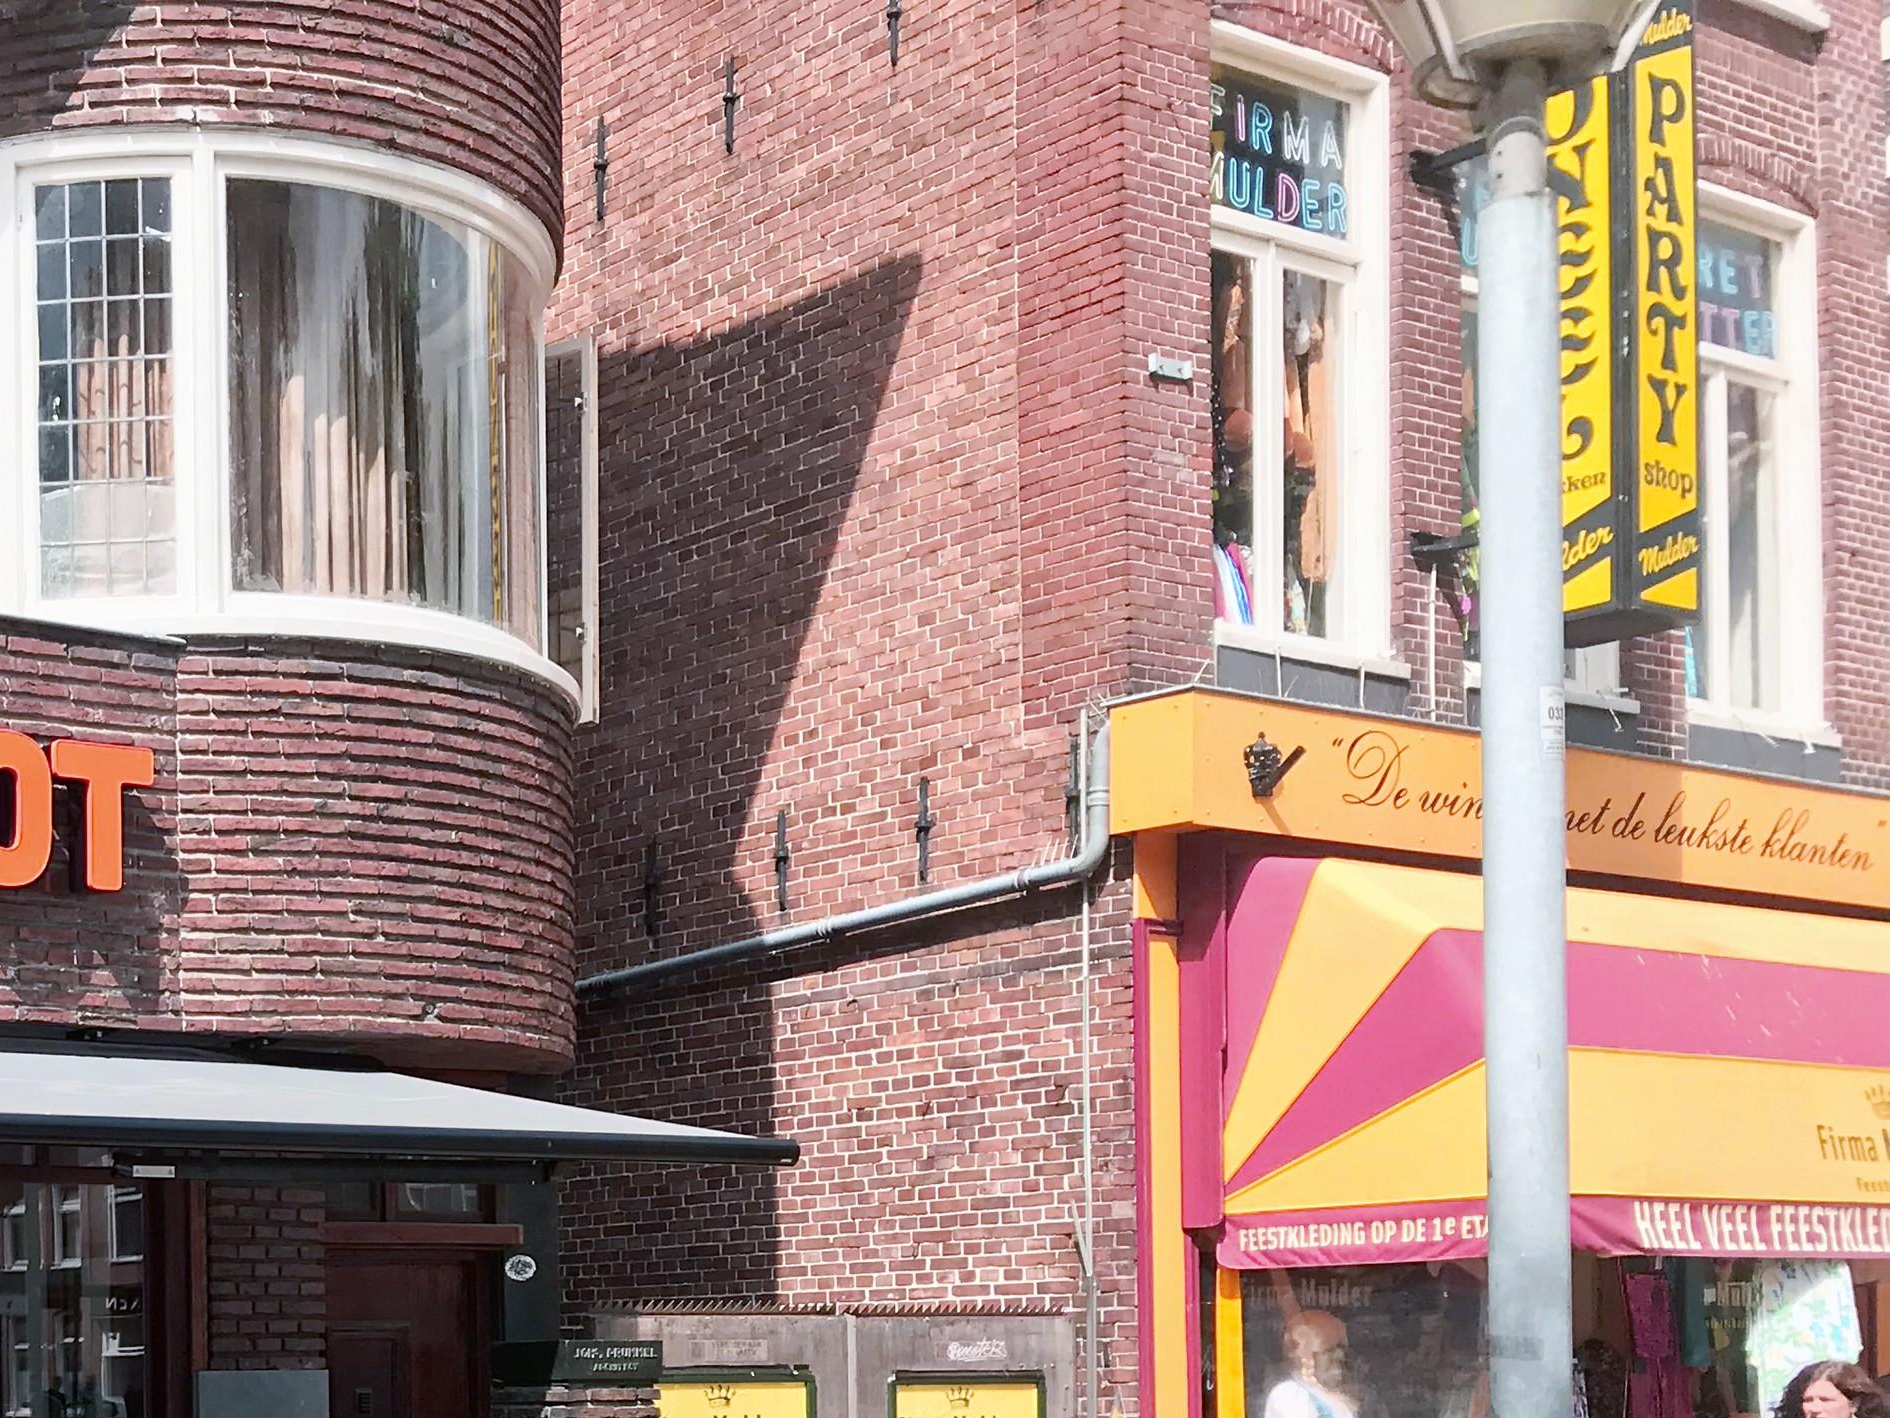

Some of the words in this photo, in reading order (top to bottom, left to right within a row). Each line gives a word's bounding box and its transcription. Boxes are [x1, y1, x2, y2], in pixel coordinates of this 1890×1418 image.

[1211, 82, 1343, 170] FIRMA
[1643, 71, 1690, 447] PARTY
[1644, 459, 1694, 499] shop
[1562, 526, 1614, 572] lder
[1638, 530, 1700, 577] Mulder
[1611, 792, 1646, 841] de
[1653, 790, 1755, 856] leukste
[1816, 1123, 1880, 1163] Firma
[1239, 1221, 1366, 1252] FEESTKLEDING
[1370, 1219, 1397, 1245] OP
[1401, 1218, 1427, 1244] DE
[1633, 1200, 1702, 1250] HEEL
[1702, 1202, 1767, 1251] VEEL
